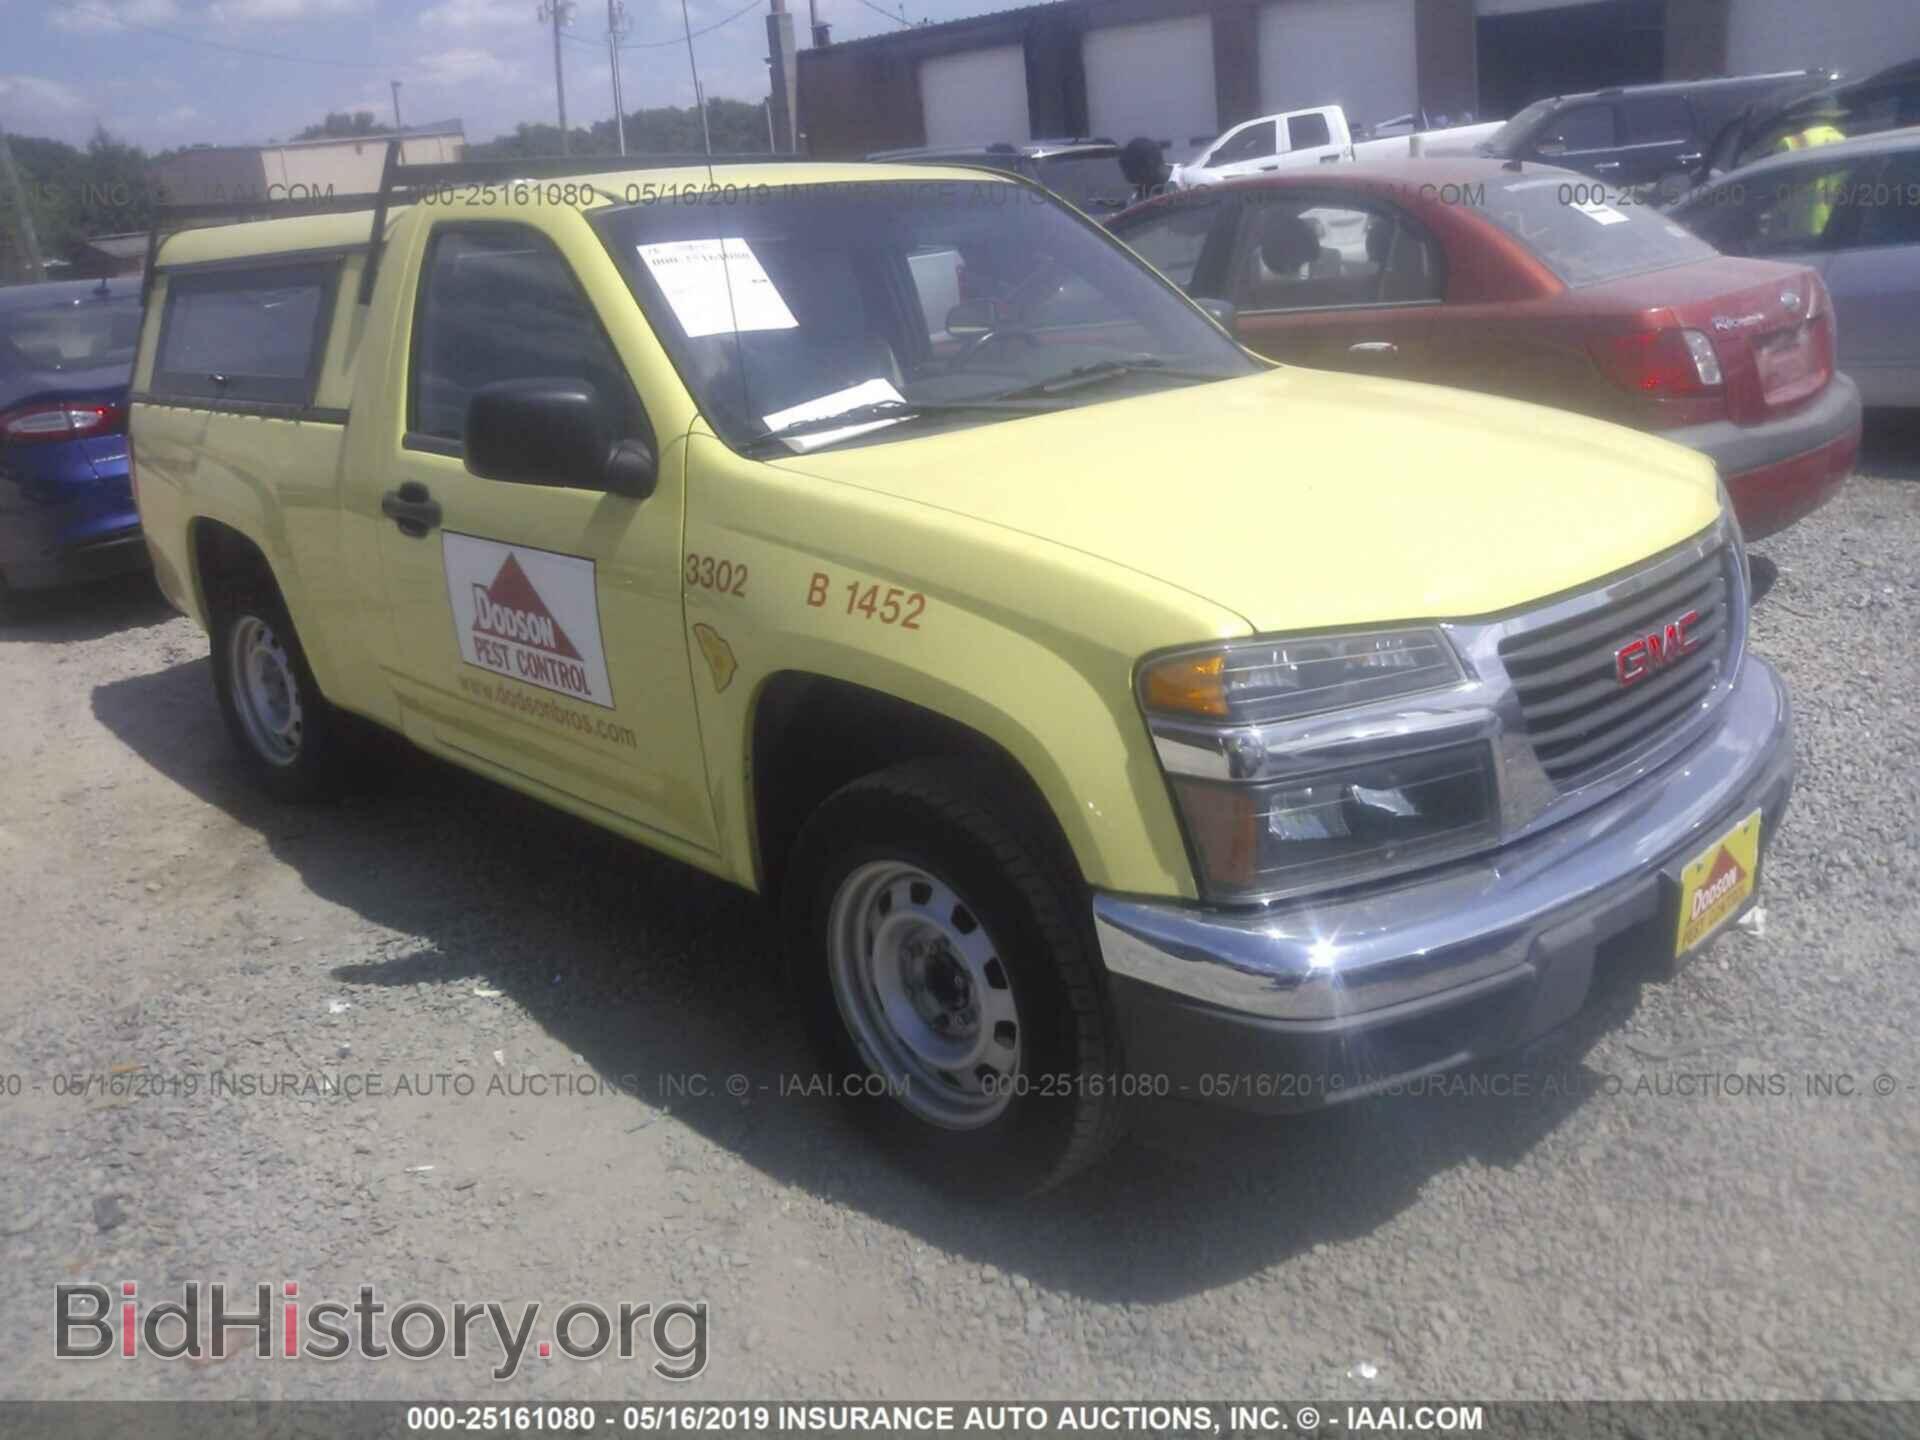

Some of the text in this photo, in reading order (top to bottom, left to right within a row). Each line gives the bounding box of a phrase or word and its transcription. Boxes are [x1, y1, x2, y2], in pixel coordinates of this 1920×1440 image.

[683, 554, 748, 598] 3302
[806, 572, 926, 630] B 1452
[474, 584, 556, 649] DODSON
[473, 636, 592, 696] PEST CONTROL
[1615, 609, 1697, 689] GMC
